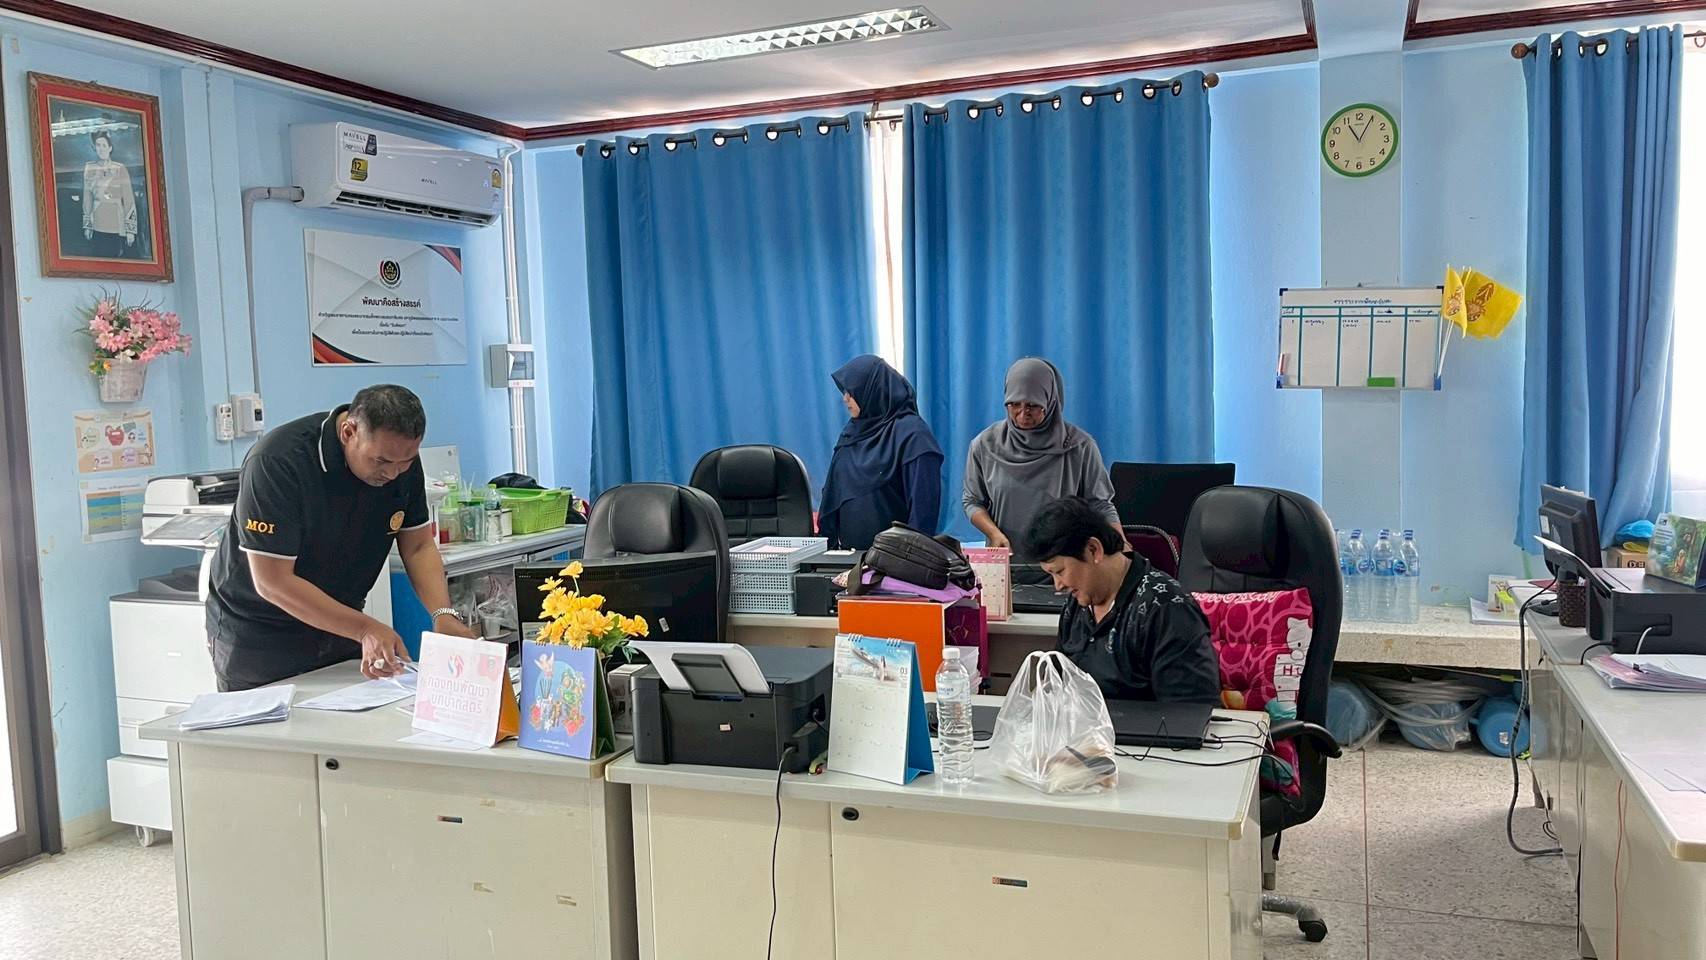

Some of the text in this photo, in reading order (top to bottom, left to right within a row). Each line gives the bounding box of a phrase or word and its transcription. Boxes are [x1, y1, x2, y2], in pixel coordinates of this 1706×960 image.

[1343, 117, 1350, 125] 11
[1355, 112, 1364, 121] 12
[1332, 126, 1341, 135] 10
[1379, 122, 1386, 131] 2
[1383, 134, 1390, 143] 3
[1329, 139, 1336, 148] 9
[1333, 151, 1340, 160] 8
[1379, 147, 1386, 156] 4
[354, 161, 362, 171] 12
[1343, 160, 1350, 169] 7
[1355, 161, 1362, 170] 6
[1369, 157, 1376, 166] 5
[245, 518, 275, 534] MOI
[427, 676, 490, 697] กองทุนพัฒนา
